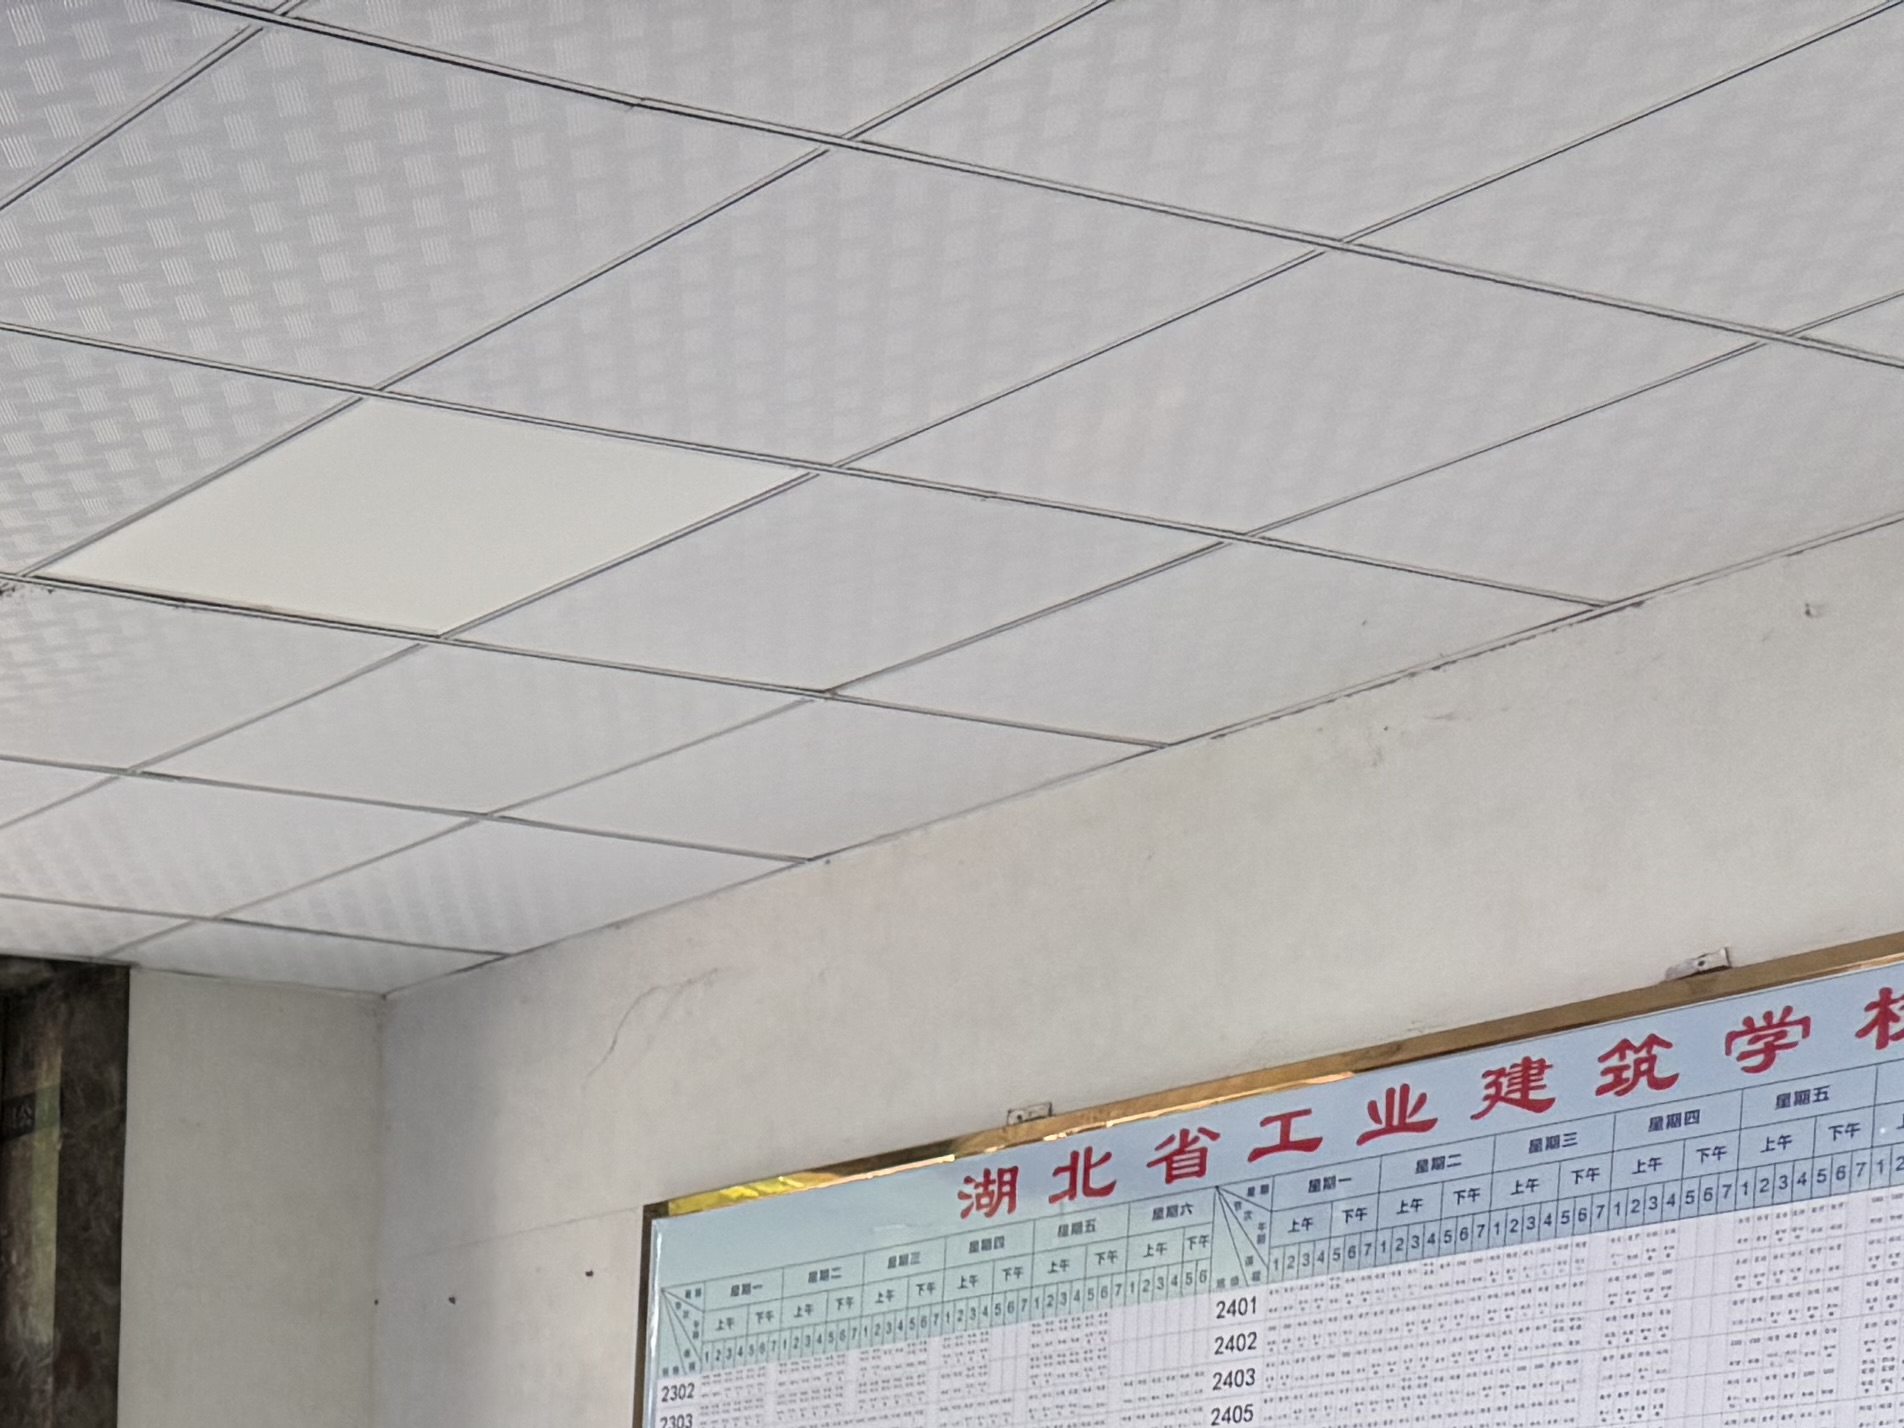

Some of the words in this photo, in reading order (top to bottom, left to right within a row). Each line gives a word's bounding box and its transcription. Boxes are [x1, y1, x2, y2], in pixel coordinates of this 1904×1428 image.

[1308, 1176, 1352, 1194] 星期一
[1415, 1153, 1462, 1175] 星期二
[1529, 1131, 1578, 1153] 星期三
[1648, 1109, 1701, 1133] 星期四
[1775, 1084, 1831, 1110] 星期五
[1288, 1217, 1314, 1234] 上午
[1342, 1207, 1368, 1224] 下午
[1396, 1198, 1423, 1215] 上午
[1453, 1187, 1481, 1205] 下午
[1510, 1178, 1539, 1196] 上午
[1571, 1166, 1600, 1185] 下午
[1632, 1157, 1662, 1175] 上午
[1696, 1145, 1727, 1164] 下午
[1761, 1135, 1792, 1153] 上午
[1827, 1122, 1861, 1142] 下午
[1510, 1219, 1519, 1233] 2
[1527, 1216, 1535, 1230] 3
[1544, 1213, 1552, 1226] 4
[1561, 1210, 1570, 1224] 5
[1578, 1208, 1587, 1222] 6
[1597, 1205, 1605, 1219] 7
[1631, 1199, 1640, 1213] 2
[1649, 1196, 1657, 1210] 3
[1666, 1193, 1675, 1206] 4
[1685, 1190, 1694, 1204] 5
[1704, 1187, 1713, 1202] 6
[1722, 1184, 1732, 1199] 7
[1760, 1178, 1769, 1193] 2
[1779, 1175, 1788, 1190] 3
[1797, 1172, 1807, 1185] 4
[1817, 1168, 1826, 1183] 5
[1836, 1165, 1846, 1180] 6
[1856, 1162, 1867, 1177] 7
[1216, 1296, 1256, 1319] 2401
[1215, 1332, 1257, 1355] 2402
[1213, 1368, 1255, 1391] 2403
[662, 1382, 695, 1402] 2302
[1211, 1404, 1253, 1426] 2405
